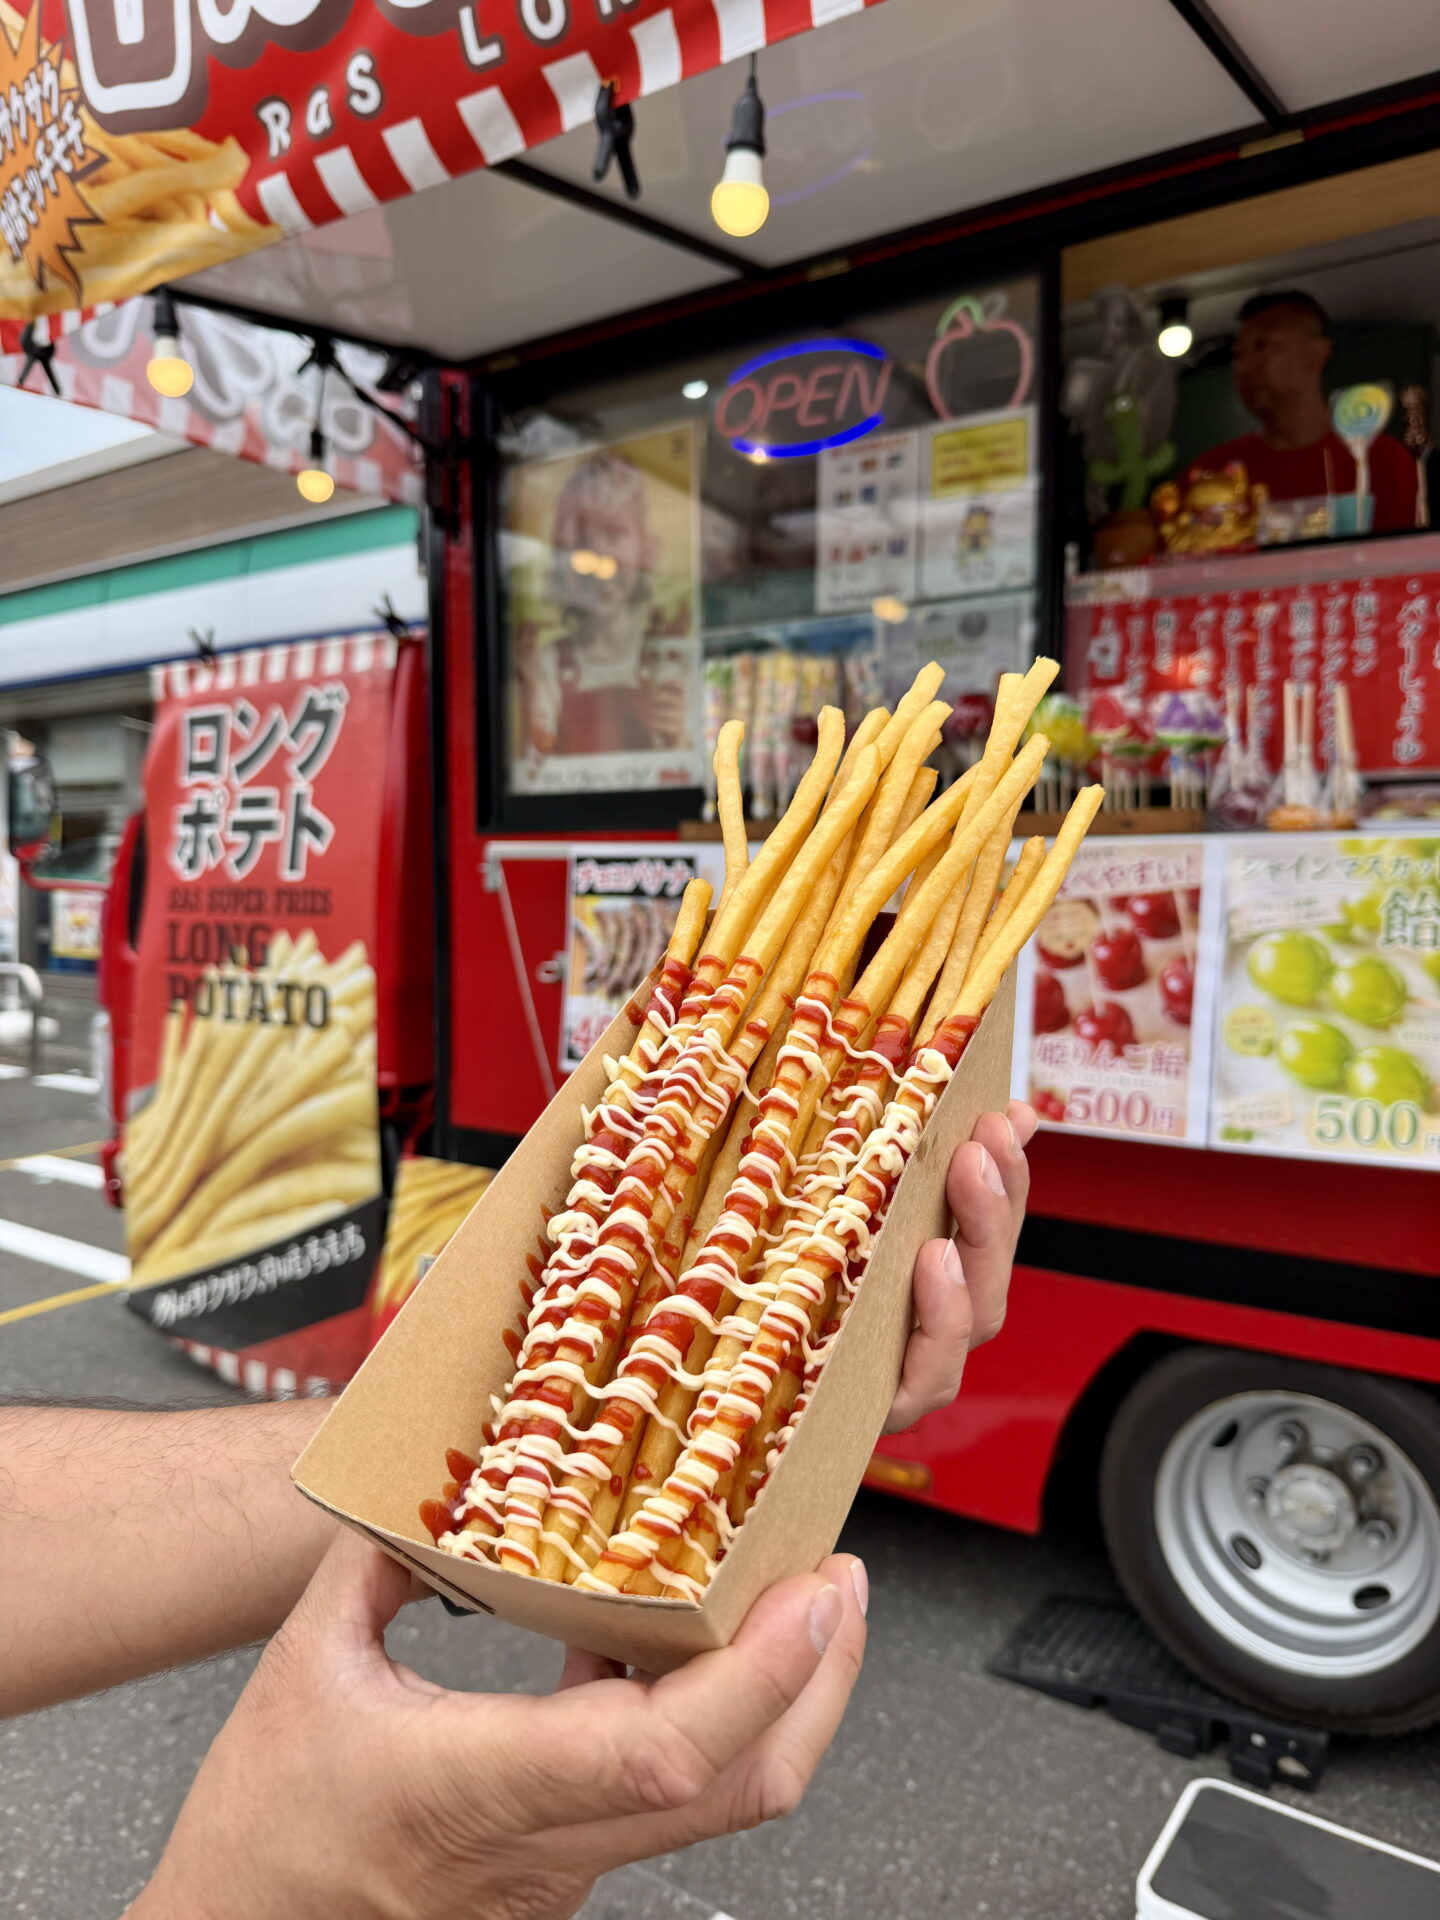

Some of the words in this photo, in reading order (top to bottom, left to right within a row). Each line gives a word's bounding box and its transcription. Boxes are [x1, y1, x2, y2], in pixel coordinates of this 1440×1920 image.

[714, 361, 893, 438] OPEN
[180, 681, 350, 785] ロング
[169, 785, 337, 882] ポテト
[208, 886, 266, 914] SUPER
[275, 887, 332, 917] FRIES
[167, 921, 271, 968] LONG
[167, 972, 330, 1029] POTATO
